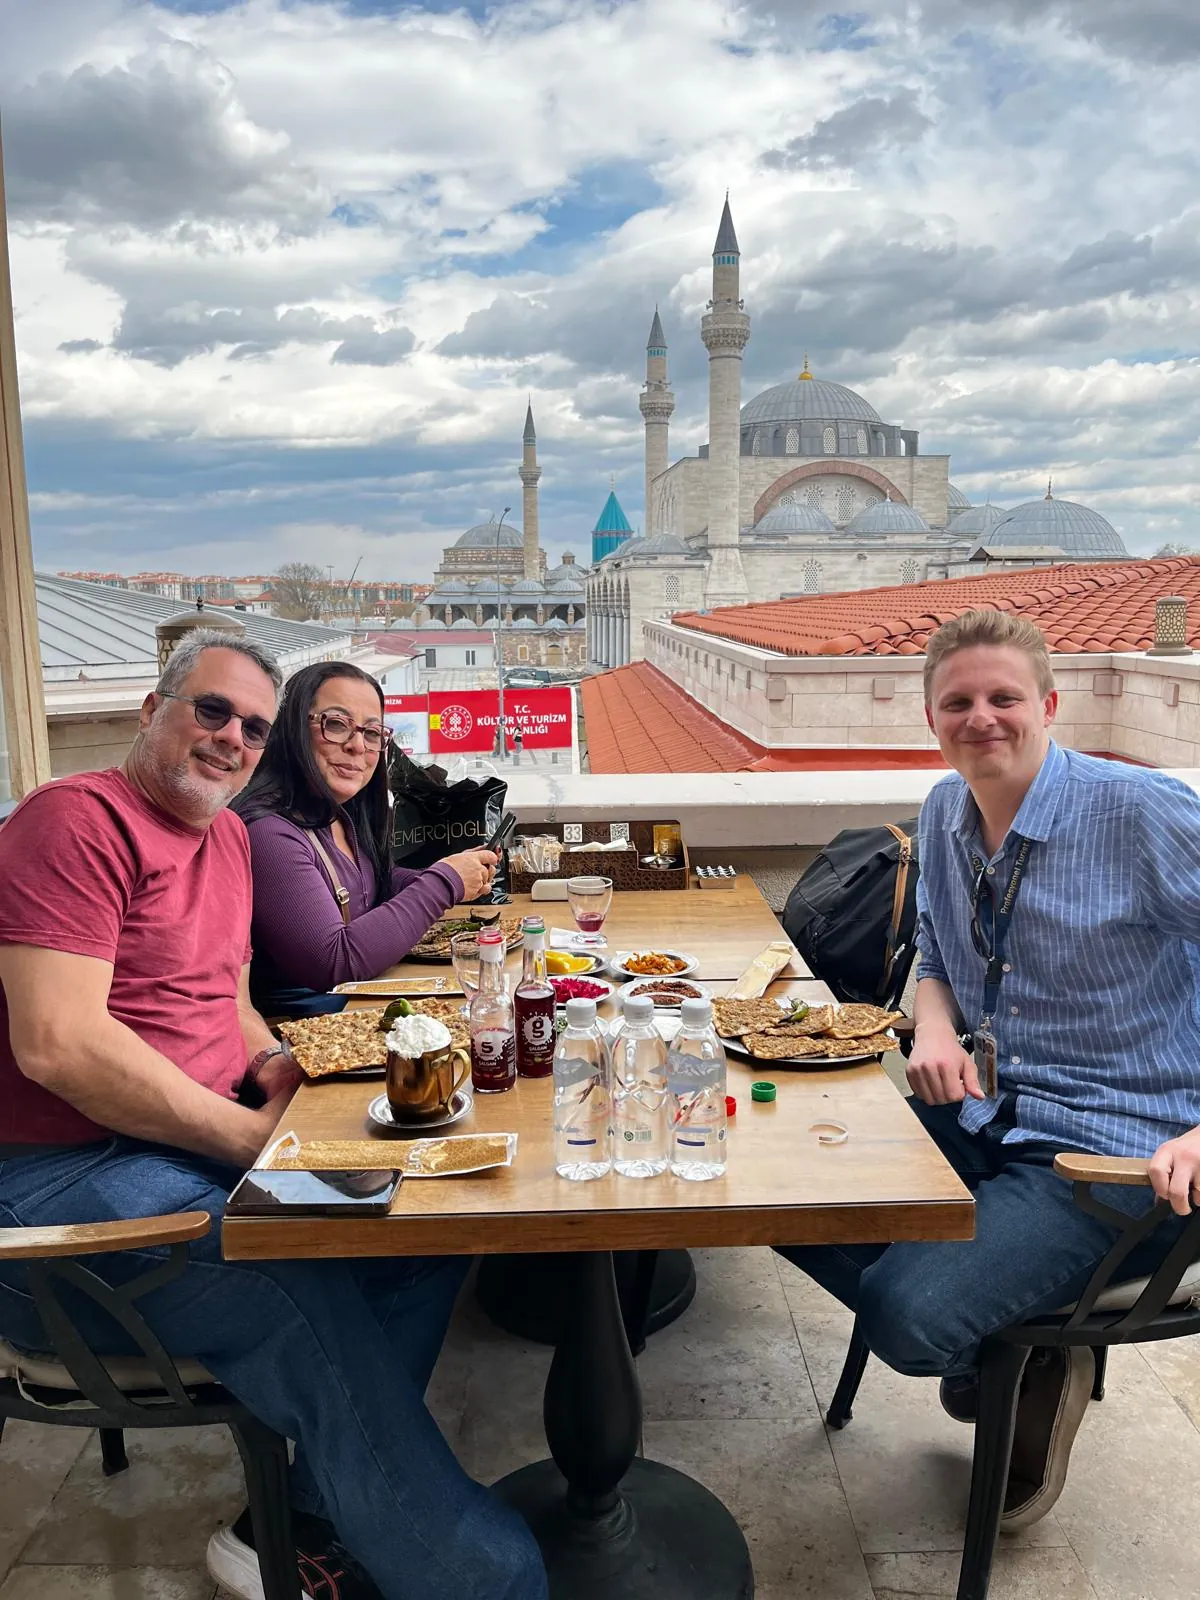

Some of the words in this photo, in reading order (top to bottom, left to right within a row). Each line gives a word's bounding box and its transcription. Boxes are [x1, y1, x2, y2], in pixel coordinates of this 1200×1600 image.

[514, 705, 531, 714] T.C.
[477, 714, 515, 726] KÜLTÜR
[516, 715, 529, 724] VE
[531, 713, 567, 724] TURİZM
[503, 724, 549, 736] AKNLIĞI
[564, 825, 582, 841] 33
[1000, 867, 1021, 914] Profesyonel
[1015, 842, 1031, 866] Turist
